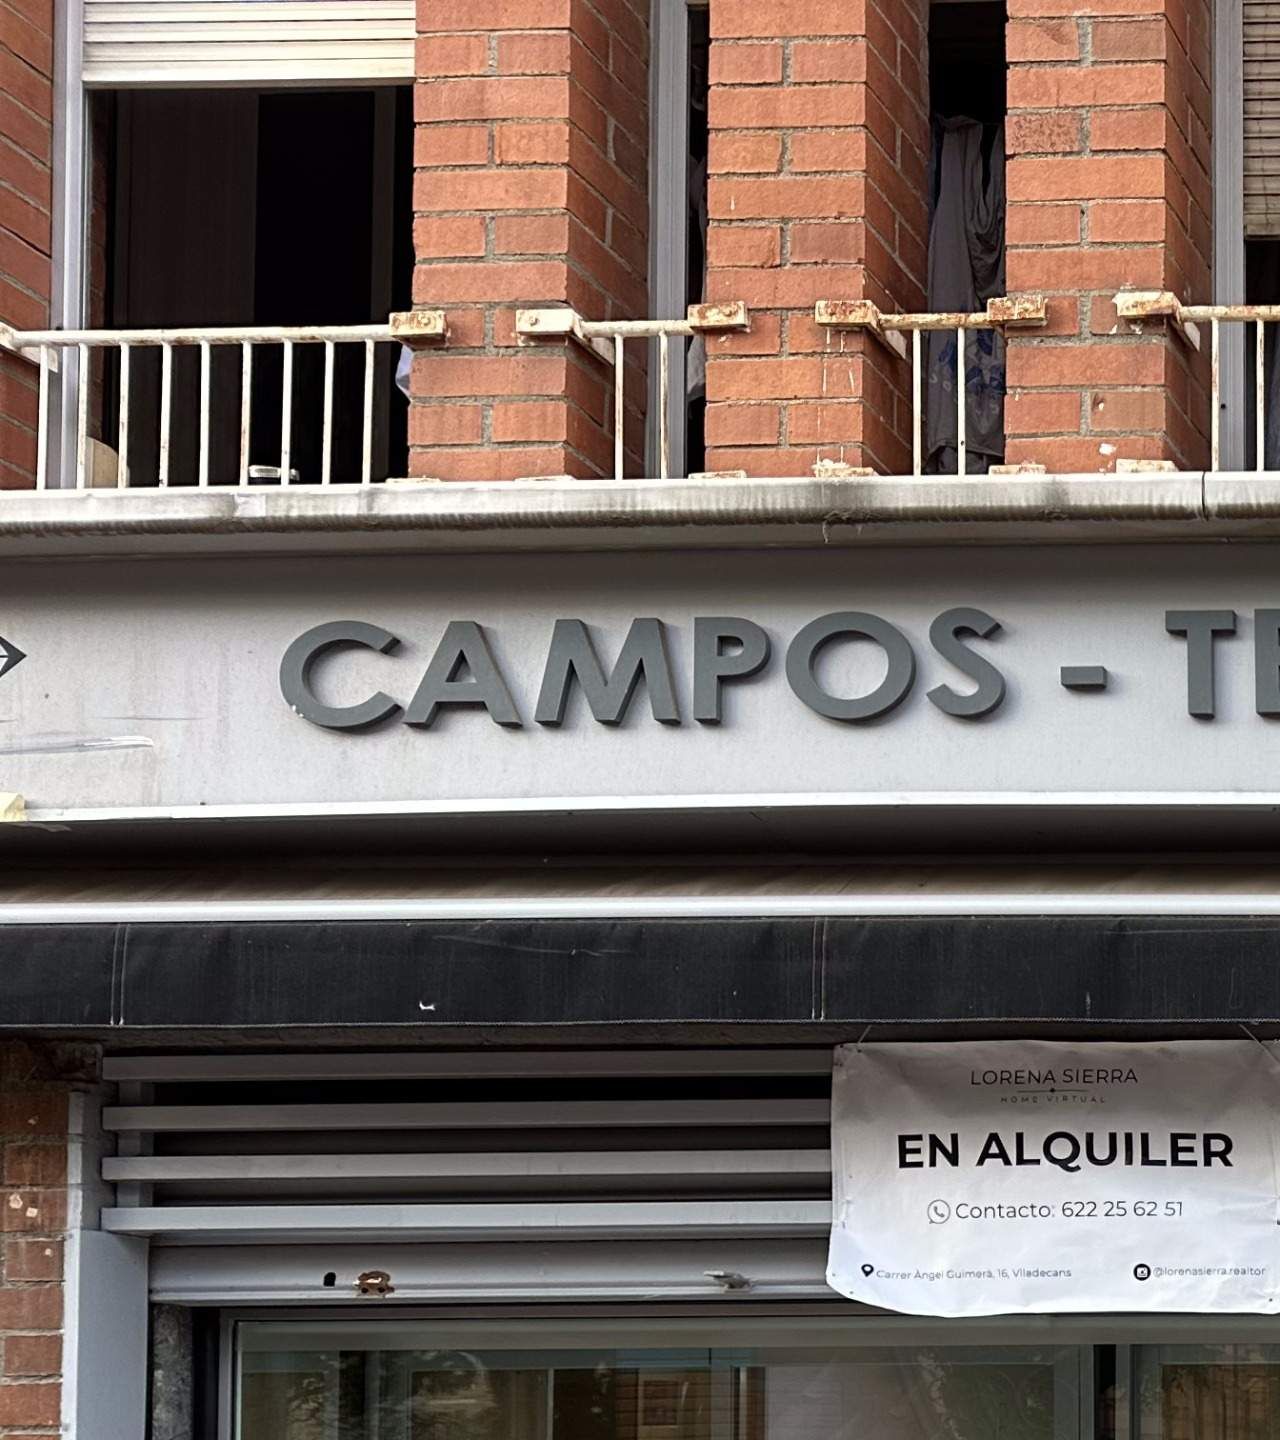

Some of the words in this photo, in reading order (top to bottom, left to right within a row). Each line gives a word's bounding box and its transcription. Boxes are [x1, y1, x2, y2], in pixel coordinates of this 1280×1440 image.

[279, 606, 1006, 729] CAMPOS
[970, 1070, 1056, 1086] LORENA
[1062, 1068, 1139, 1084] SIERRA
[1000, 1096, 1039, 1104] HOME
[1047, 1094, 1106, 1104] VIRTUAL
[897, 1133, 960, 1169] EN
[975, 1131, 1234, 1173] ALQUILER
[955, 1202, 1055, 1220] Contacto:
[1061, 1202, 1098, 1218] 622
[1104, 1201, 1128, 1218] 25
[1133, 1201, 1159, 1217] 62
[1164, 1201, 1184, 1217] 51
[876, 1269, 911, 1280] Carrer
[1012, 1267, 1072, 1279] Viladecans
[1153, 1266, 1267, 1279] @lorenasierra.realtor
